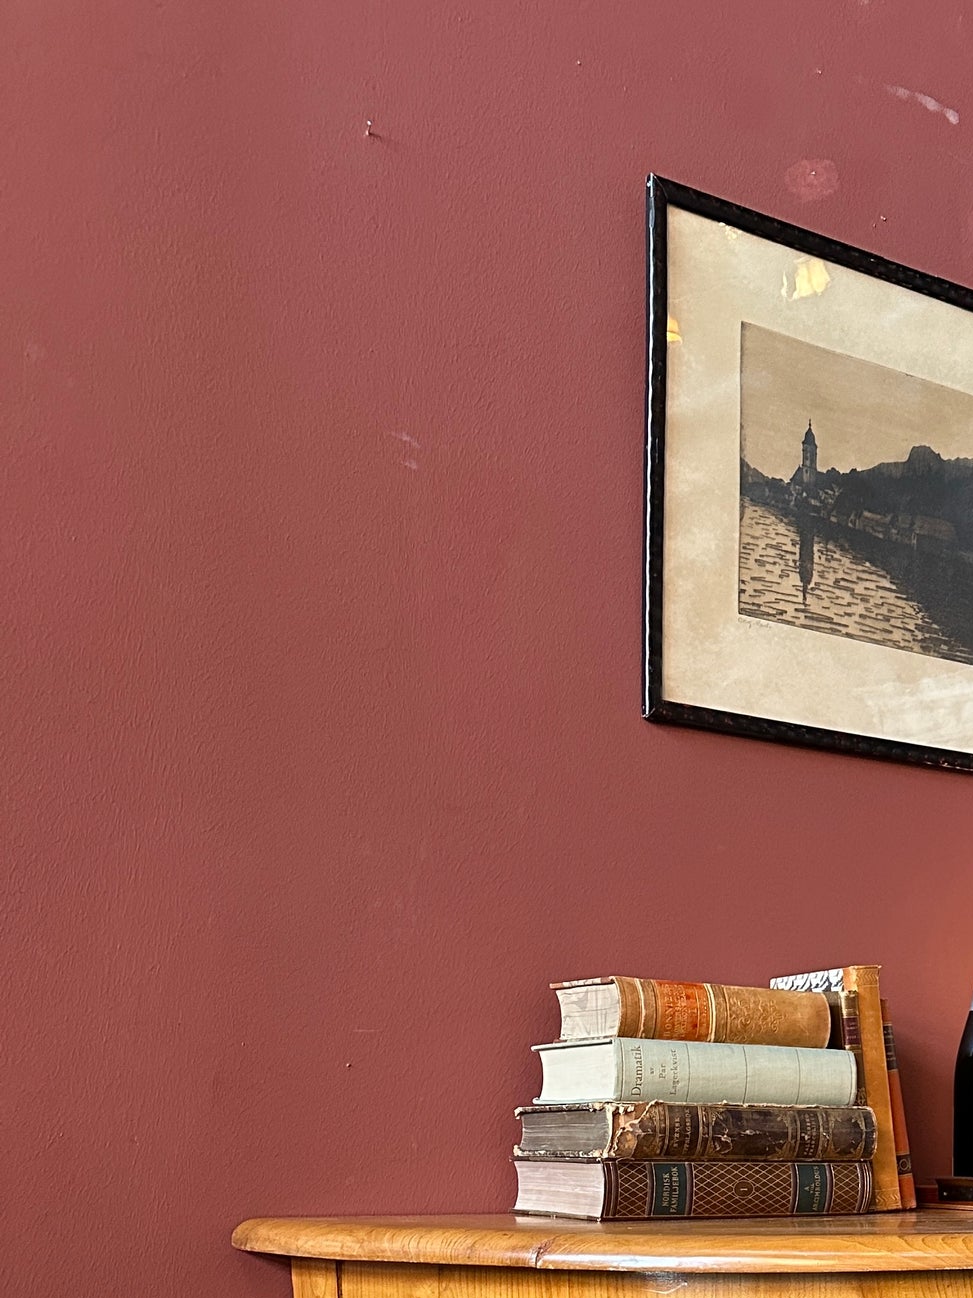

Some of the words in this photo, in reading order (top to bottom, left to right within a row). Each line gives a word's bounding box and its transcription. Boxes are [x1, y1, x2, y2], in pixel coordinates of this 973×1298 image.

[630, 1045, 643, 1096] Dramatik
[669, 1049, 680, 1095] Lagerkvist
[662, 1172, 671, 1207] NORDISK
[669, 1166, 680, 1213] FAMILJEBOK
